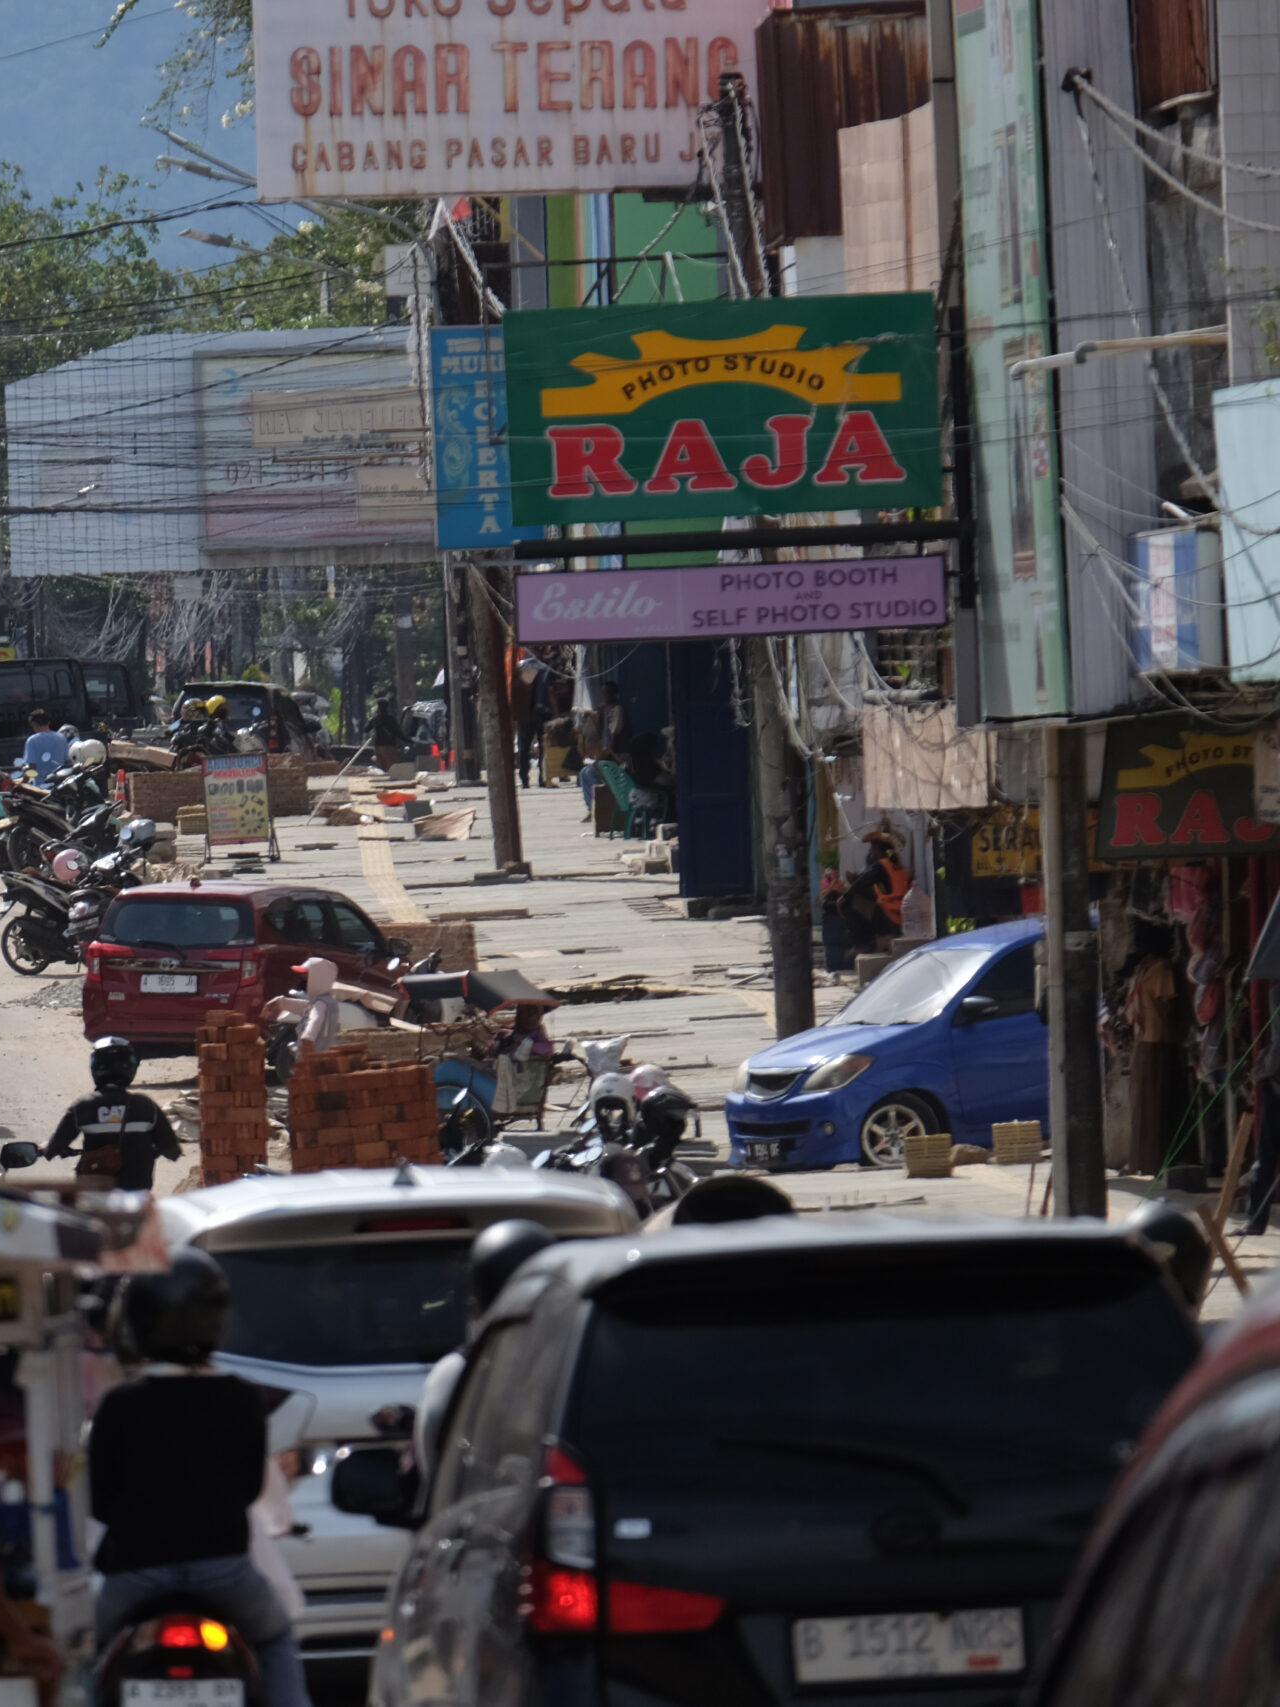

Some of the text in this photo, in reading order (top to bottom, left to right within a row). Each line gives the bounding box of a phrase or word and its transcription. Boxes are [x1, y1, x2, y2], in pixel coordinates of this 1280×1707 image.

[290, 36, 738, 117] SINAR TERANG
[291, 139, 428, 172] CABANG
[445, 135, 554, 168] PASAR
[573, 133, 662, 165] BARU
[621, 354, 826, 401] PHOTO STUDIO
[544, 409, 908, 499] RAJA
[719, 565, 898, 592] PHOTO BOOTH
[794, 591, 824, 601] AND
[532, 579, 664, 623] Estilo
[691, 598, 938, 629] SELF PHOTO STUDIO
[97, 1104, 127, 1123] CAT
[800, 1620, 823, 1663] B
[842, 1616, 934, 1659] 1512
